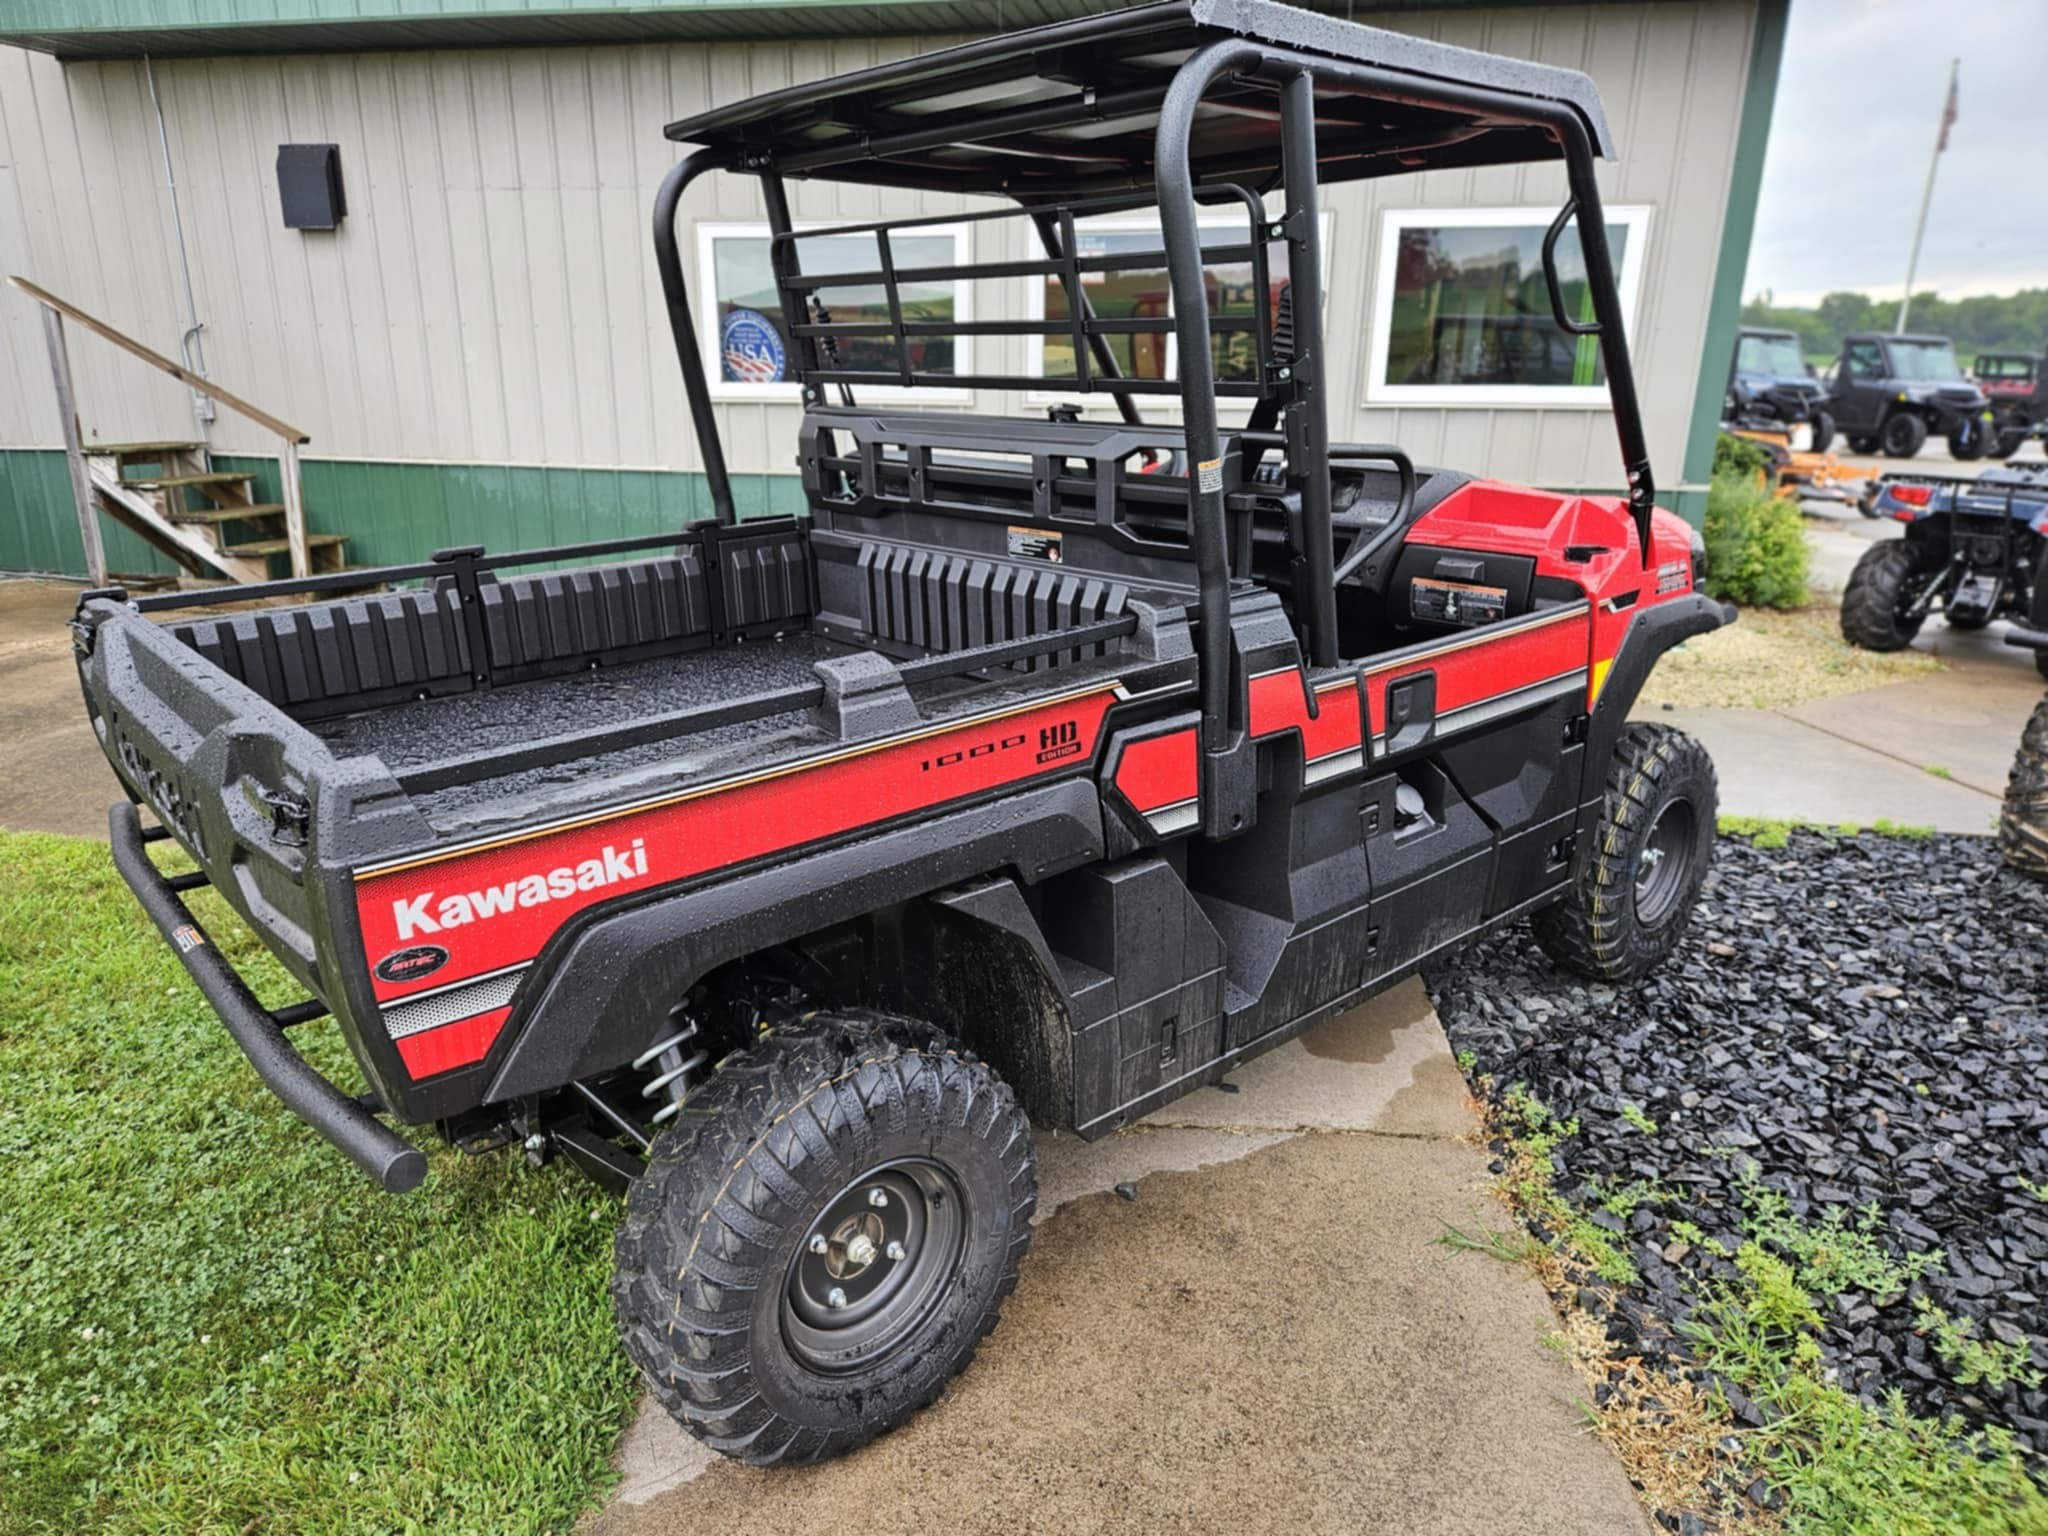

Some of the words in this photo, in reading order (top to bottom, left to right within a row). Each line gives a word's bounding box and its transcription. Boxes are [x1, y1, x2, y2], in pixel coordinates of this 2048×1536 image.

[728, 343, 774, 365] USA
[922, 734, 1026, 772] 1000
[1040, 720, 1077, 750] HD
[1040, 745, 1079, 763] EDITION
[392, 838, 649, 940] Kawasaki
